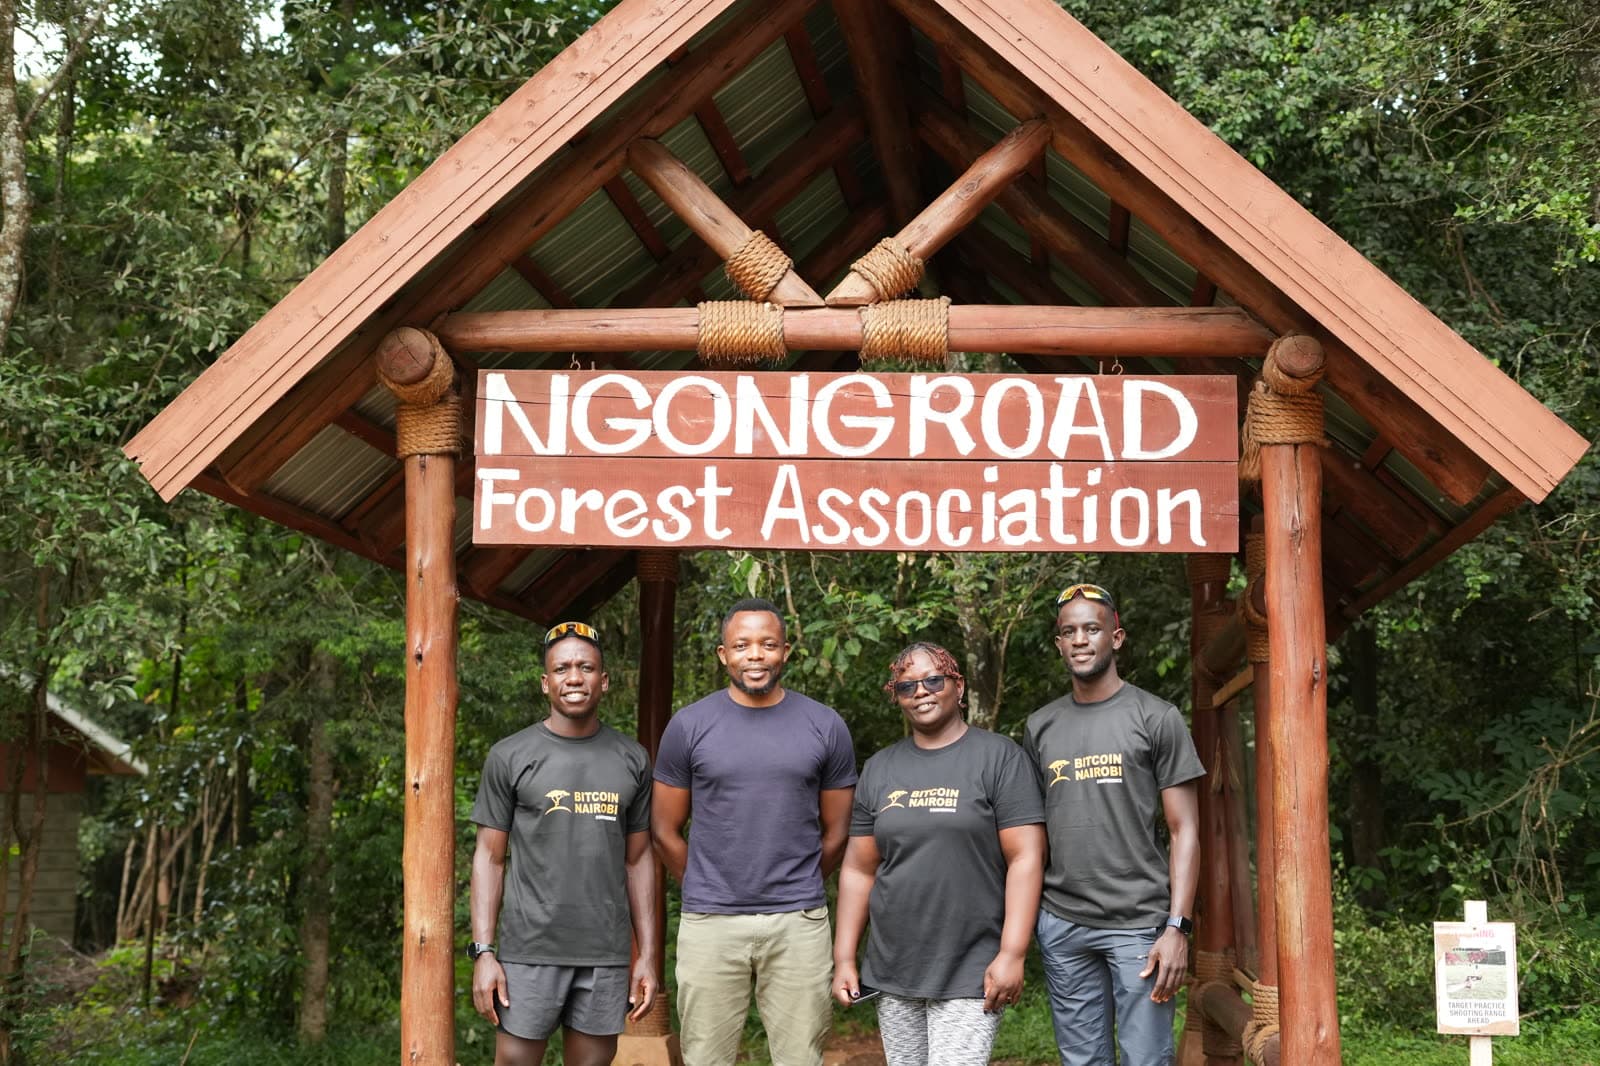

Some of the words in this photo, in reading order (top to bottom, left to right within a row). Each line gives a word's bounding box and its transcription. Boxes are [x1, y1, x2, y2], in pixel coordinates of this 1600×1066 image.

[484, 373, 896, 457] NGONG
[909, 375, 1199, 461] ROAD
[477, 465, 733, 542] Forest
[760, 461, 1207, 547] Association
[1074, 753, 1122, 769] BITCOIN
[1075, 766, 1122, 781] NAIROBI
[574, 791, 619, 803] BITCOIN
[910, 787, 959, 798] BITCOIN
[574, 803, 618, 815] NAIROBI
[908, 798, 958, 808] NAIROBI
[1448, 1001, 1472, 1009] TARGET
[1449, 1009, 1483, 1017] SHOOTING
[1484, 1009, 1506, 1017] RANGE
